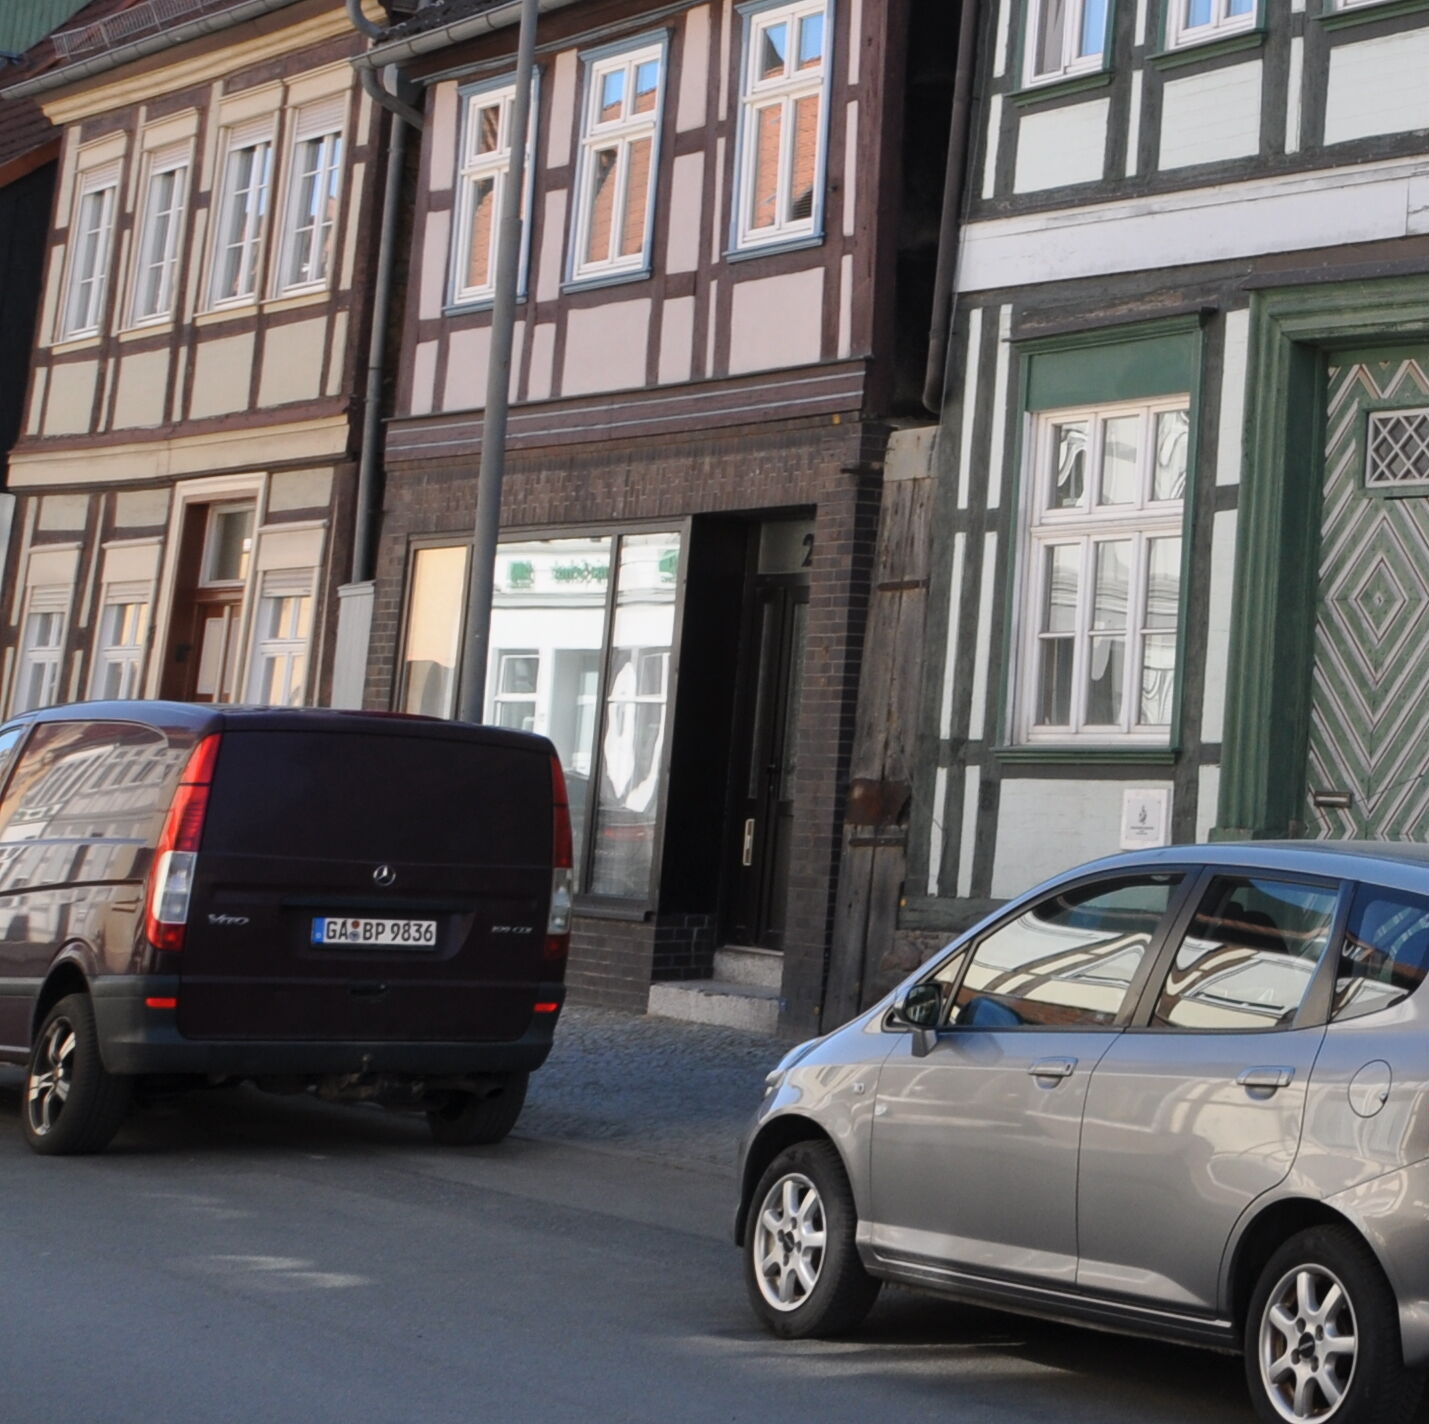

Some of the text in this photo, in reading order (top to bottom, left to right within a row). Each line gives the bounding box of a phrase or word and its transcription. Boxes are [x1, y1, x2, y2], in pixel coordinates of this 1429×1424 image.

[326, 919, 434, 943] GA BP 9836
